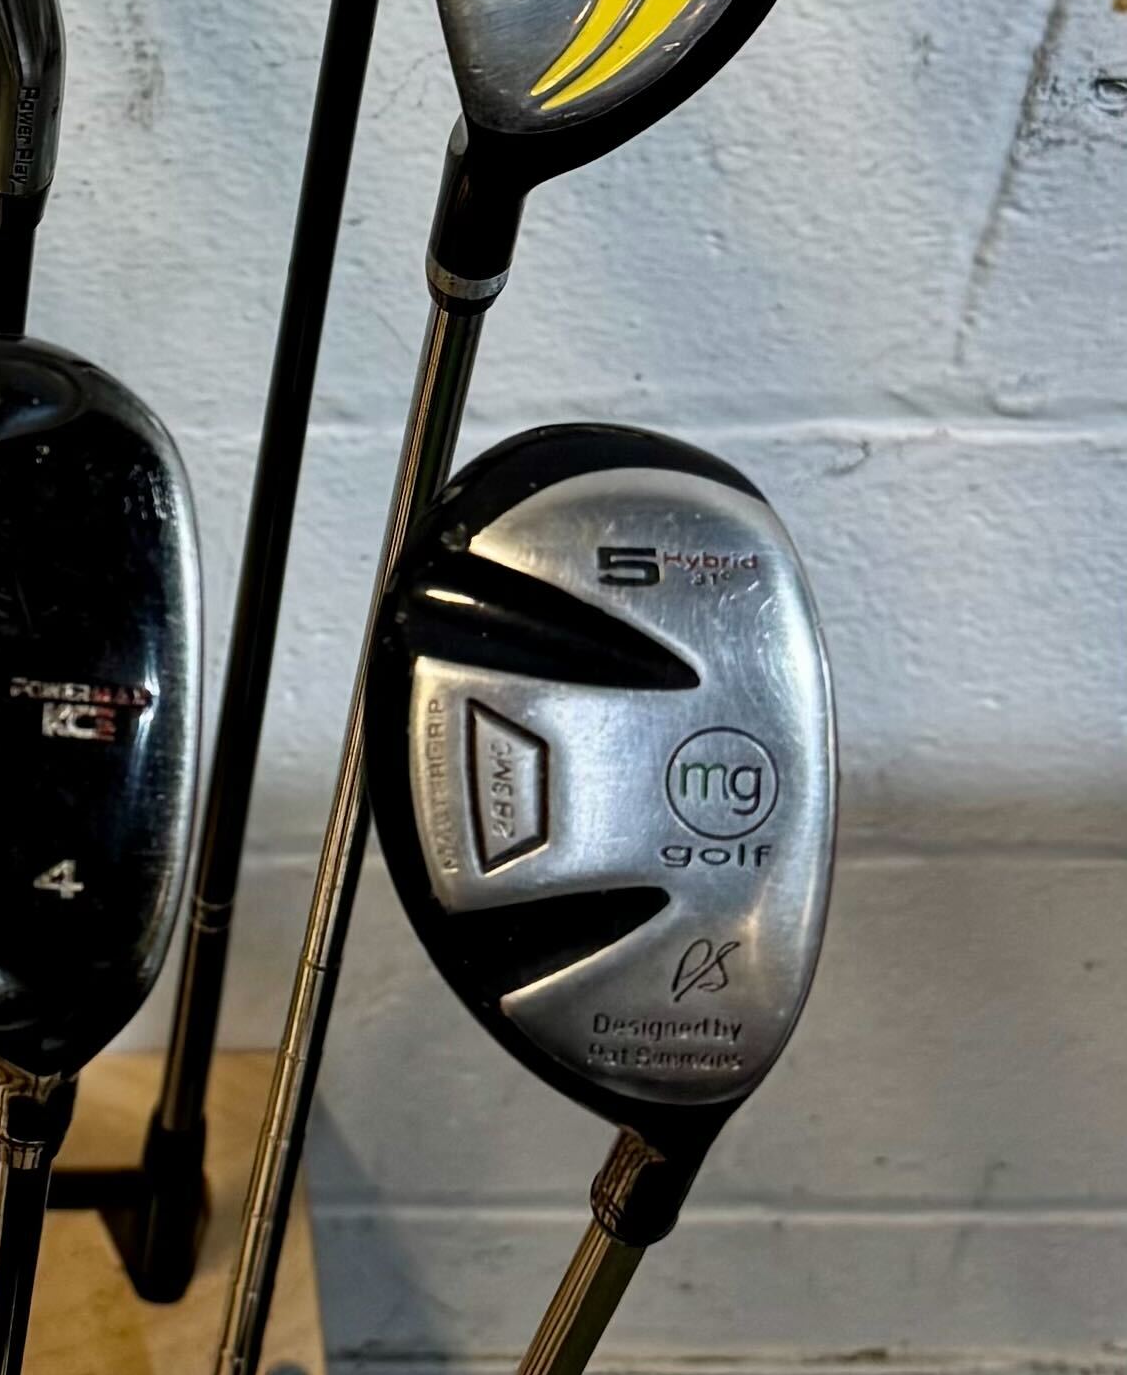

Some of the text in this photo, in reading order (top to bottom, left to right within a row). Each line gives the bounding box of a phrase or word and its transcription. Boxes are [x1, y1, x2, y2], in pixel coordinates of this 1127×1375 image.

[9, 86, 41, 187] Power Play
[597, 546, 758, 586] 5 Hybrid
[679, 759, 763, 816] mg
[660, 843, 773, 869] golf
[32, 859, 84, 899] 4
[592, 1013, 743, 1041] Designed by
